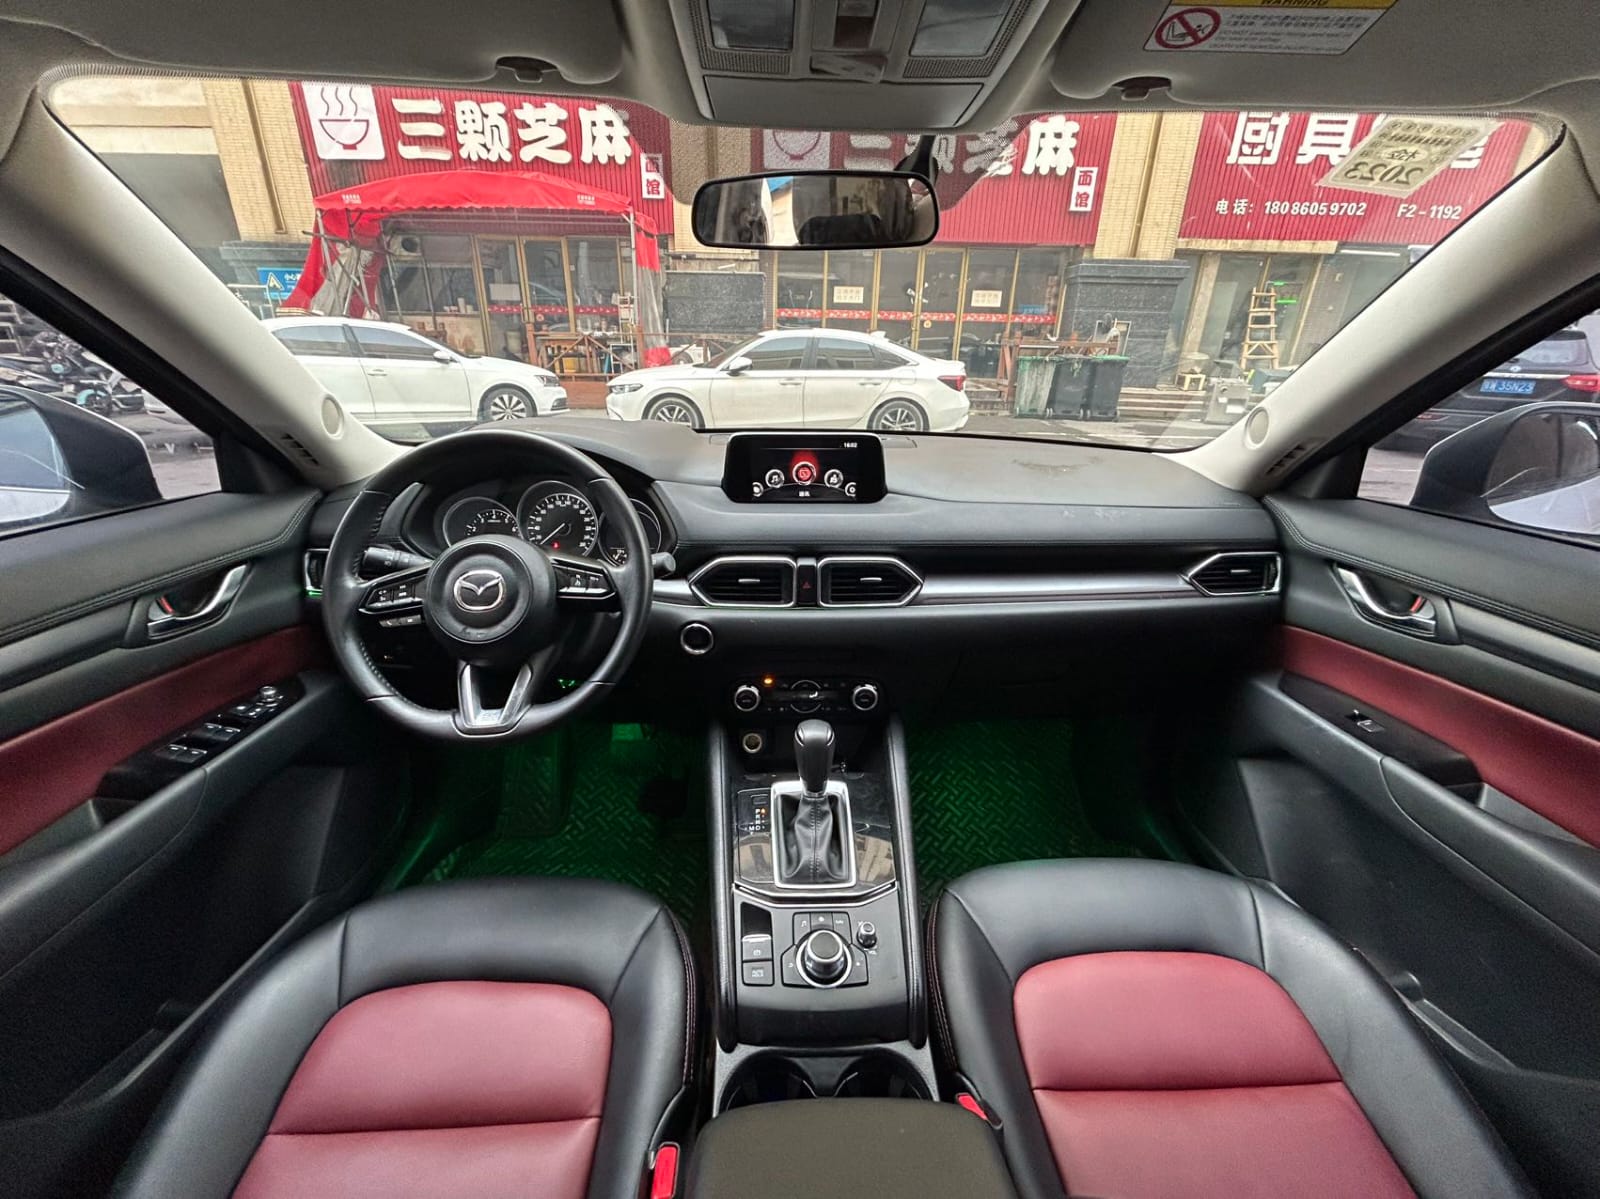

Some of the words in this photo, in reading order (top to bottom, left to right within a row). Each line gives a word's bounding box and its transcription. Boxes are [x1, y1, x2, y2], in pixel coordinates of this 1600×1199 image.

[391, 97, 632, 165] 三颗芝麻
[1075, 169, 1095, 209] 面馆
